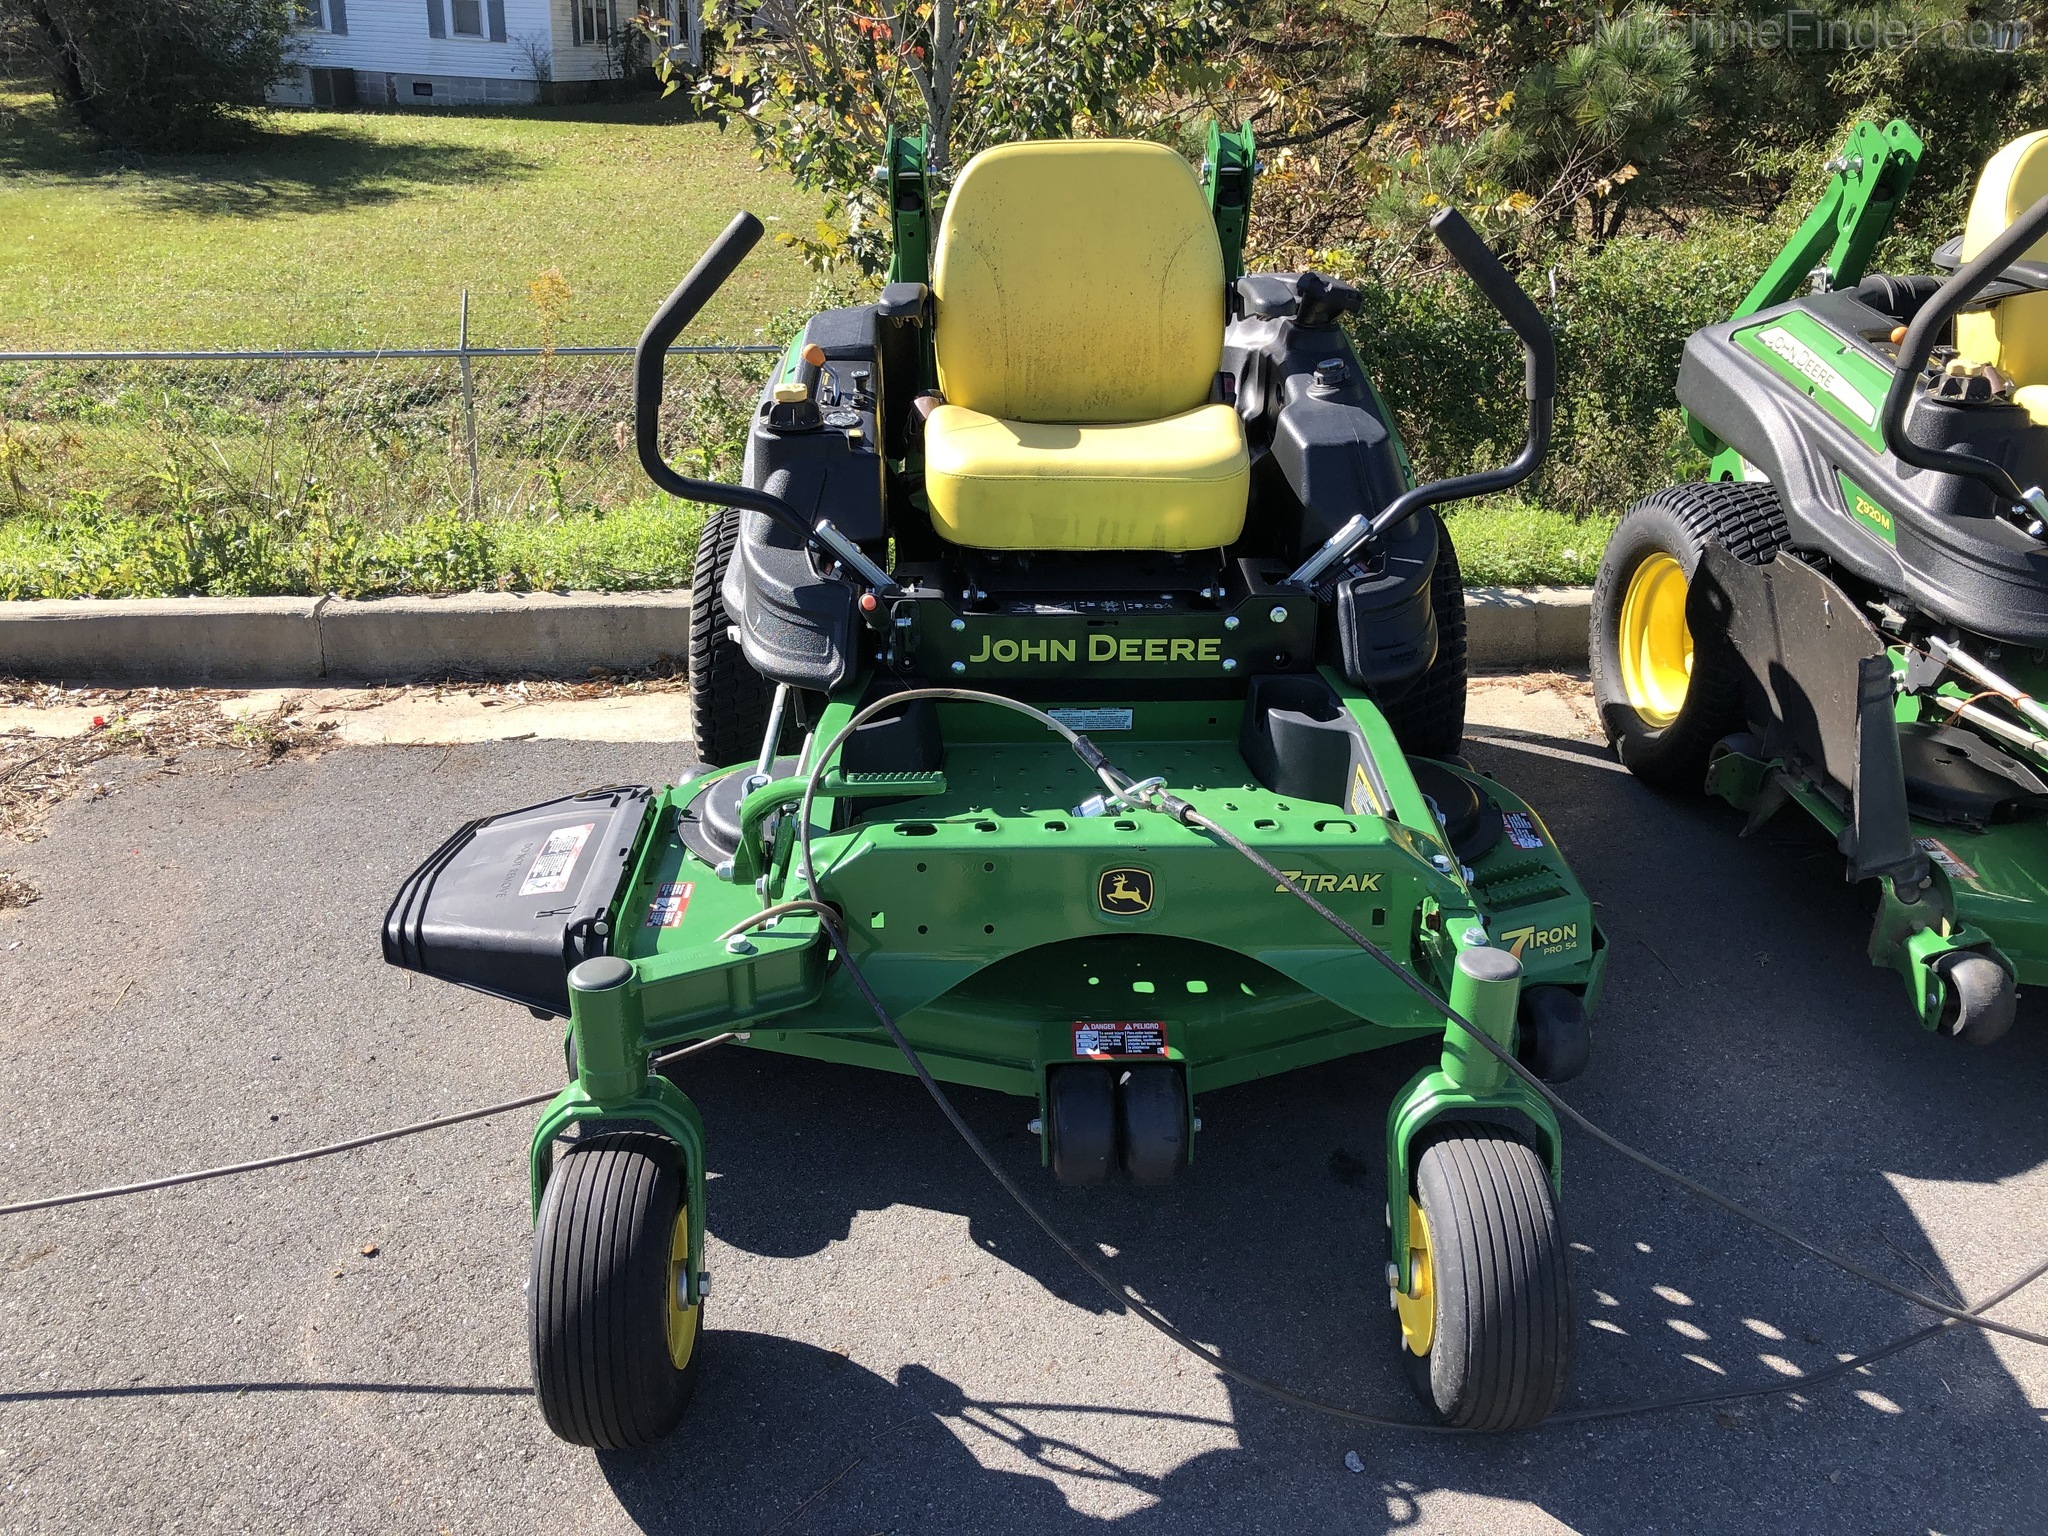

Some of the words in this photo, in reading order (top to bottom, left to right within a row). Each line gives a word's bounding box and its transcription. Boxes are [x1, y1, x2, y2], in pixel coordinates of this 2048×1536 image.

[1797, 349, 1836, 389] DEERE
[1856, 494, 1890, 531] Z920M
[969, 634, 1076, 663] JOHN
[1088, 633, 1221, 662] DEERE
[1274, 870, 1384, 893] ZTRAK
[1543, 944, 1563, 956] PRO
[1565, 941, 1578, 950] 54
[1132, 1022, 1159, 1030] PELIGRO
